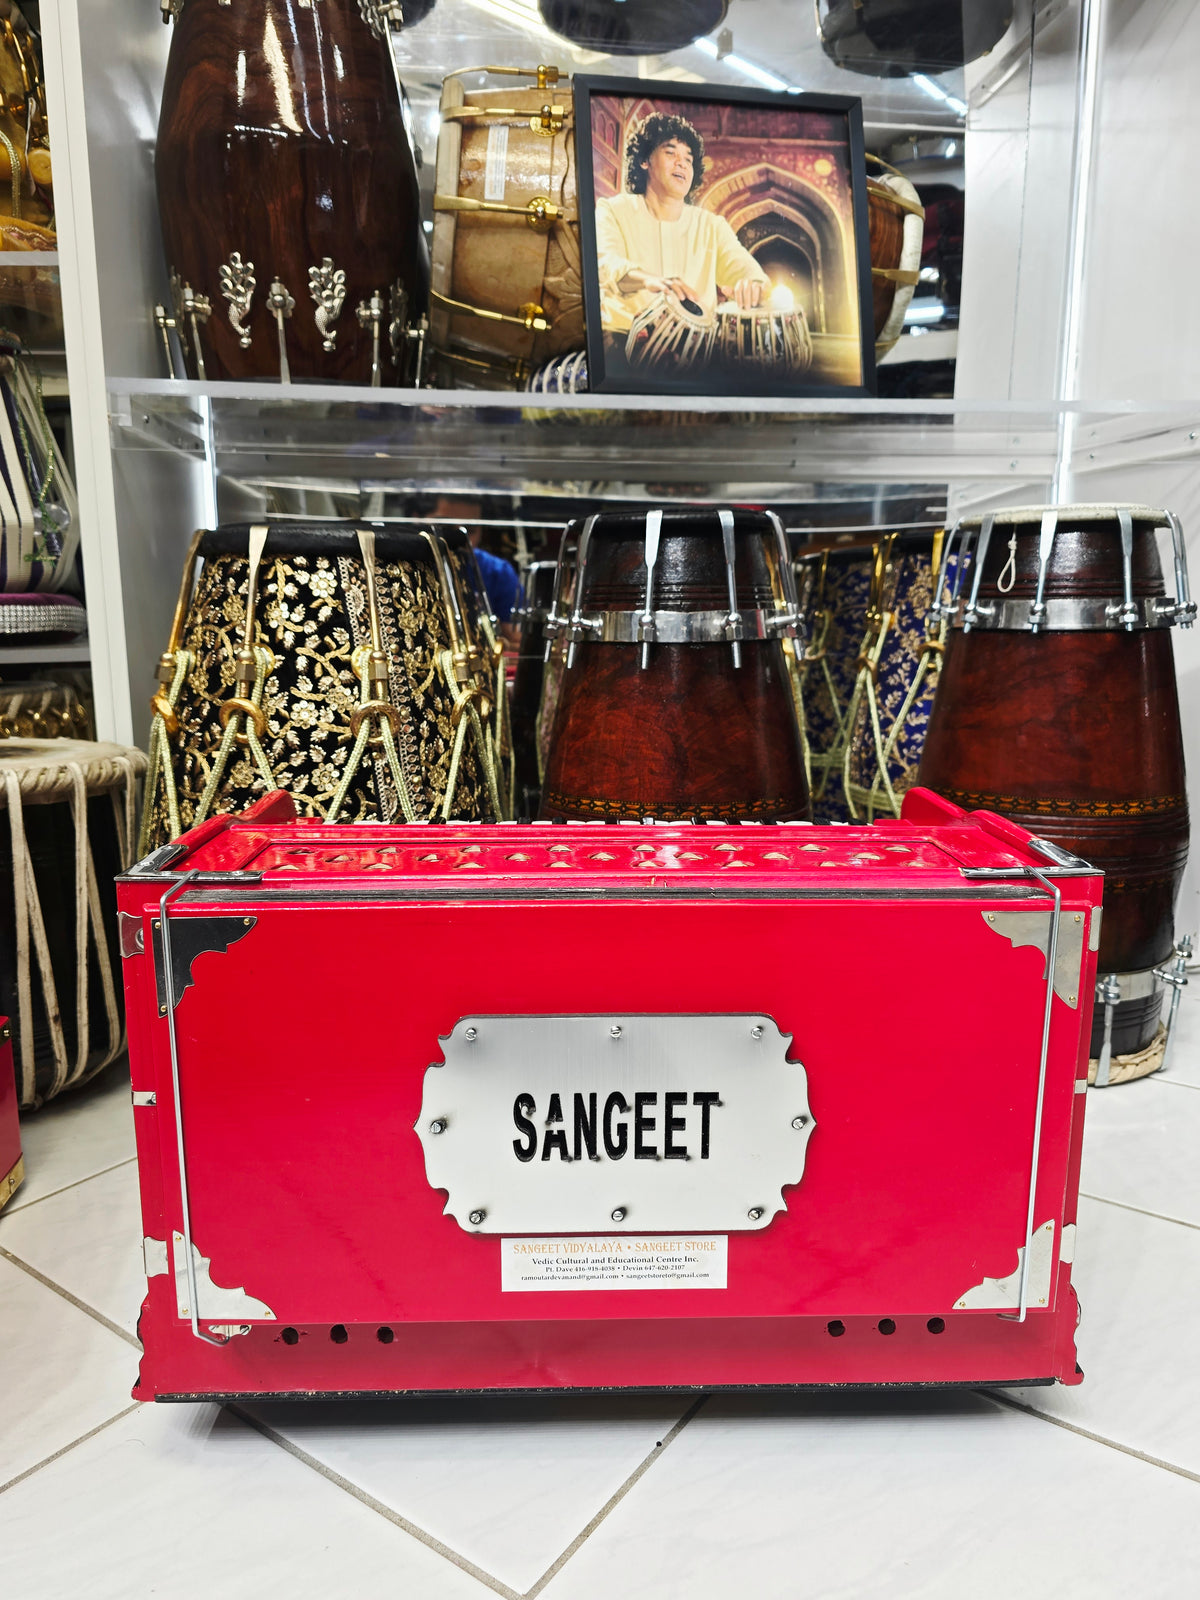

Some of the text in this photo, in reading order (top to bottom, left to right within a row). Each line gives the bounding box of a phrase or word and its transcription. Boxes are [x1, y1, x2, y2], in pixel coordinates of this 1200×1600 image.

[513, 1091, 720, 1162] SANGEET
[513, 1241, 716, 1254] SANGEET VIDYALAYA SANGEET STORE
